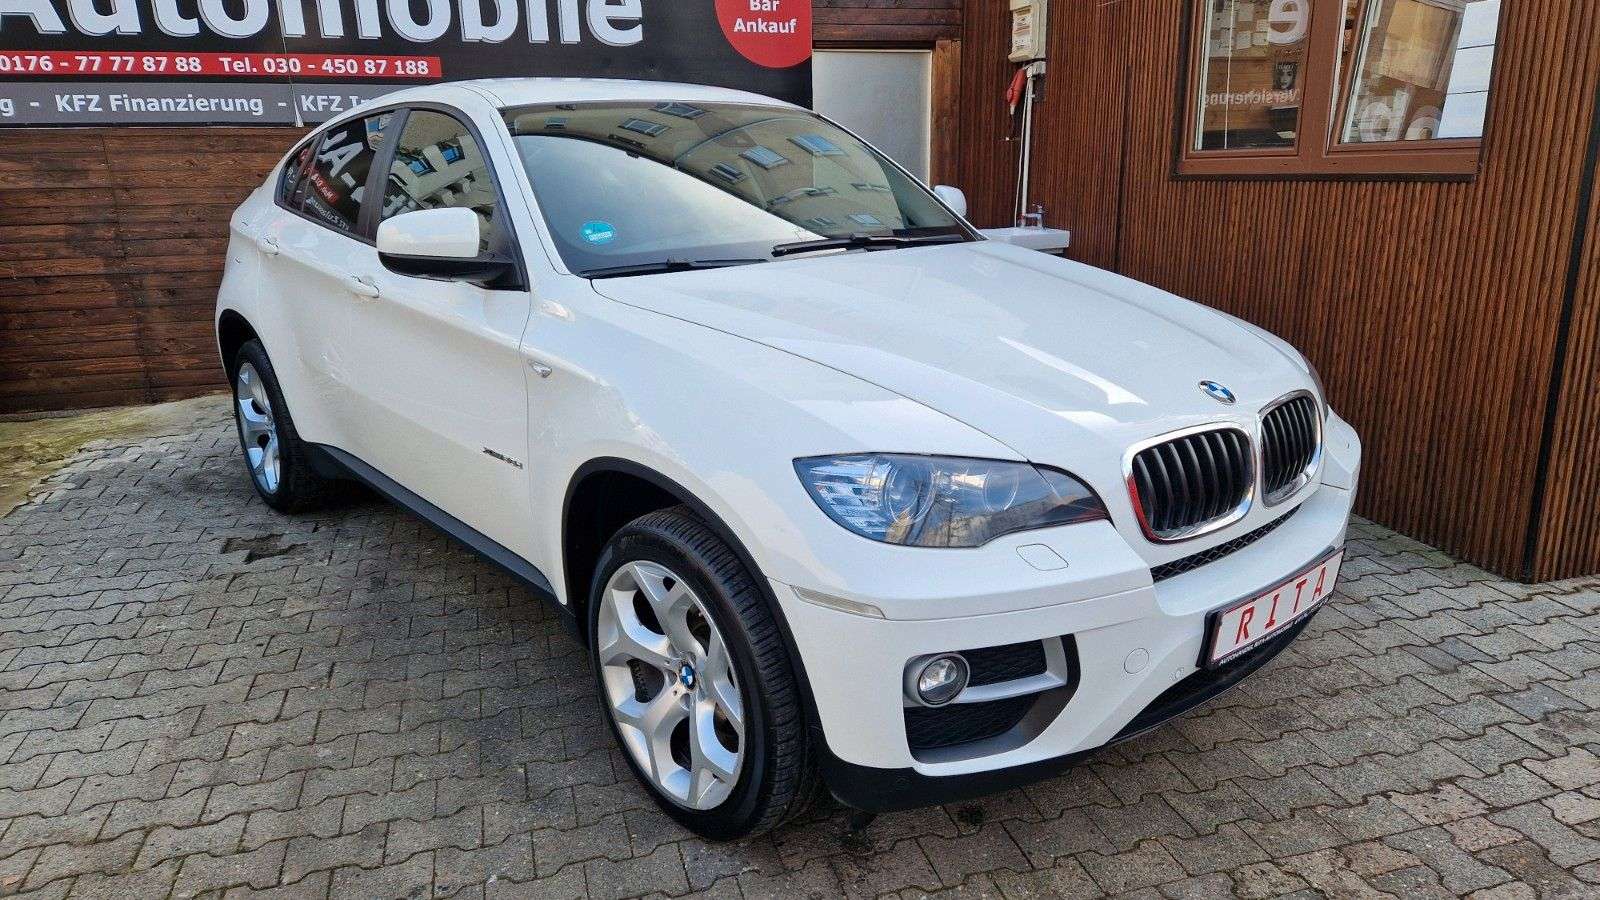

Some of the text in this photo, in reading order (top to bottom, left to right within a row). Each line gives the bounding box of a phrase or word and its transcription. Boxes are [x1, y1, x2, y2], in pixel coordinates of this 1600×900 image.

[750, 0, 779, 11] Bar
[733, 18, 797, 33] Ankauf
[0, 55, 53, 71] 0176
[75, 56, 101, 71] 77
[109, 56, 134, 71] 77
[142, 57, 167, 72] 87
[175, 57, 202, 72] 88
[219, 57, 257, 73] Tel.
[263, 58, 301, 73] 030
[321, 59, 358, 74] 450
[364, 60, 387, 74] 87
[395, 60, 429, 75] 188
[54, 94, 103, 112] KFZ
[109, 93, 264, 116] Finanzierung
[301, 95, 344, 112] KFZ
[1235, 566, 1327, 645] RITA
